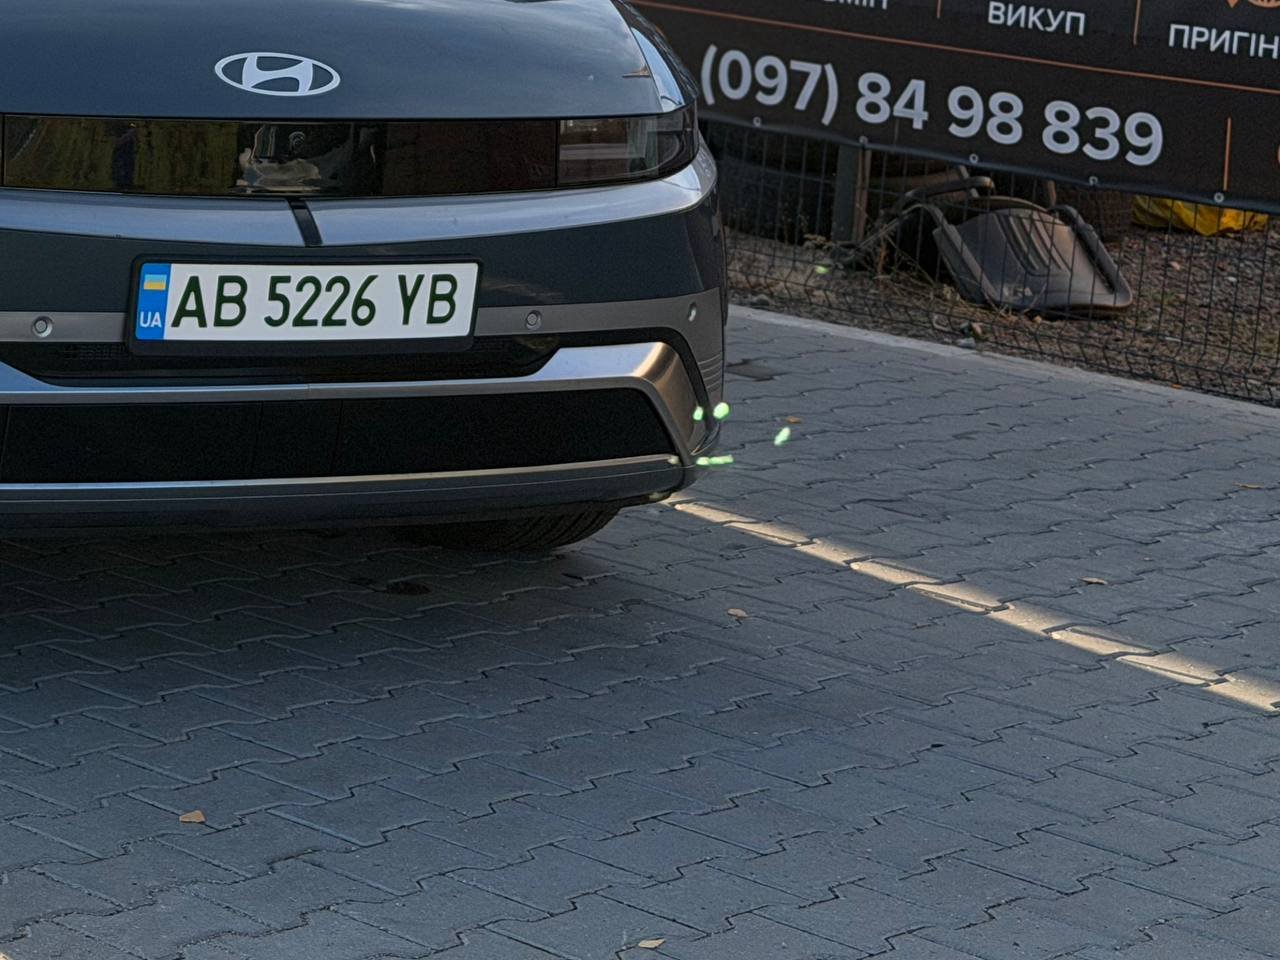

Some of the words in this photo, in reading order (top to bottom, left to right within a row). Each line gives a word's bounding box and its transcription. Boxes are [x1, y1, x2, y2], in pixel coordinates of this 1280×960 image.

[988, 1, 1086, 36] ВИКУП
[1168, 23, 1280, 59] ПРИГІН
[701, 44, 839, 126] (097)
[856, 72, 929, 130] 84
[948, 85, 1024, 145] 98
[1042, 100, 1164, 166] 839
[170, 274, 248, 329] AB
[263, 274, 379, 328] 5226
[397, 273, 458, 326] YB
[139, 311, 163, 329] UA
